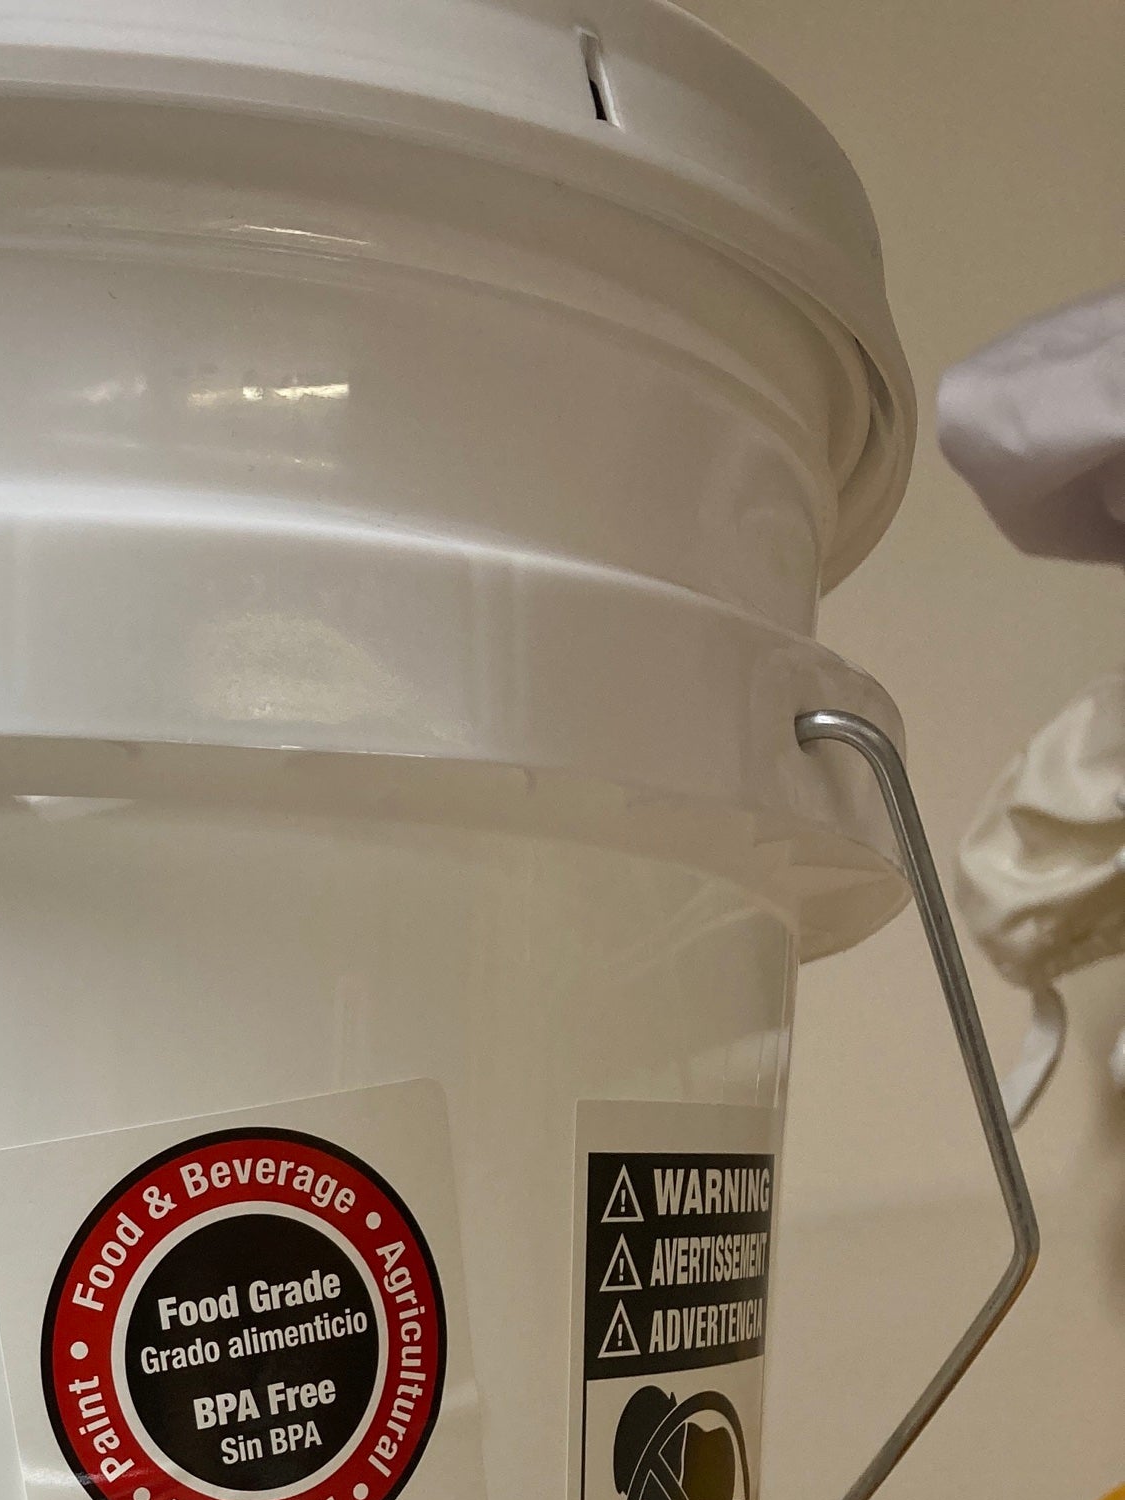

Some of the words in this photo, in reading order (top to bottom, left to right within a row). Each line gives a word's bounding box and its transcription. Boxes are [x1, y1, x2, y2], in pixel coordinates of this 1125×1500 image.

[653, 1168, 770, 1215] WARNING
[73, 1213, 144, 1311] Food
[142, 1185, 178, 1219] &
[180, 1157, 356, 1214] Beverage
[650, 1232, 768, 1287] AVERTISSEMENT
[157, 1286, 239, 1330] Food
[249, 1270, 341, 1313] Grade
[649, 1298, 763, 1353] ADVERTENCIA
[140, 1331, 220, 1374] Grado
[229, 1309, 368, 1358] alimenticio
[367, 1239, 427, 1478] Agricultural
[69, 1376, 135, 1482] Paint
[193, 1390, 261, 1430] BPA
[267, 1379, 337, 1414] Free
[221, 1433, 263, 1465] Sin
[270, 1421, 322, 1456] BPA
